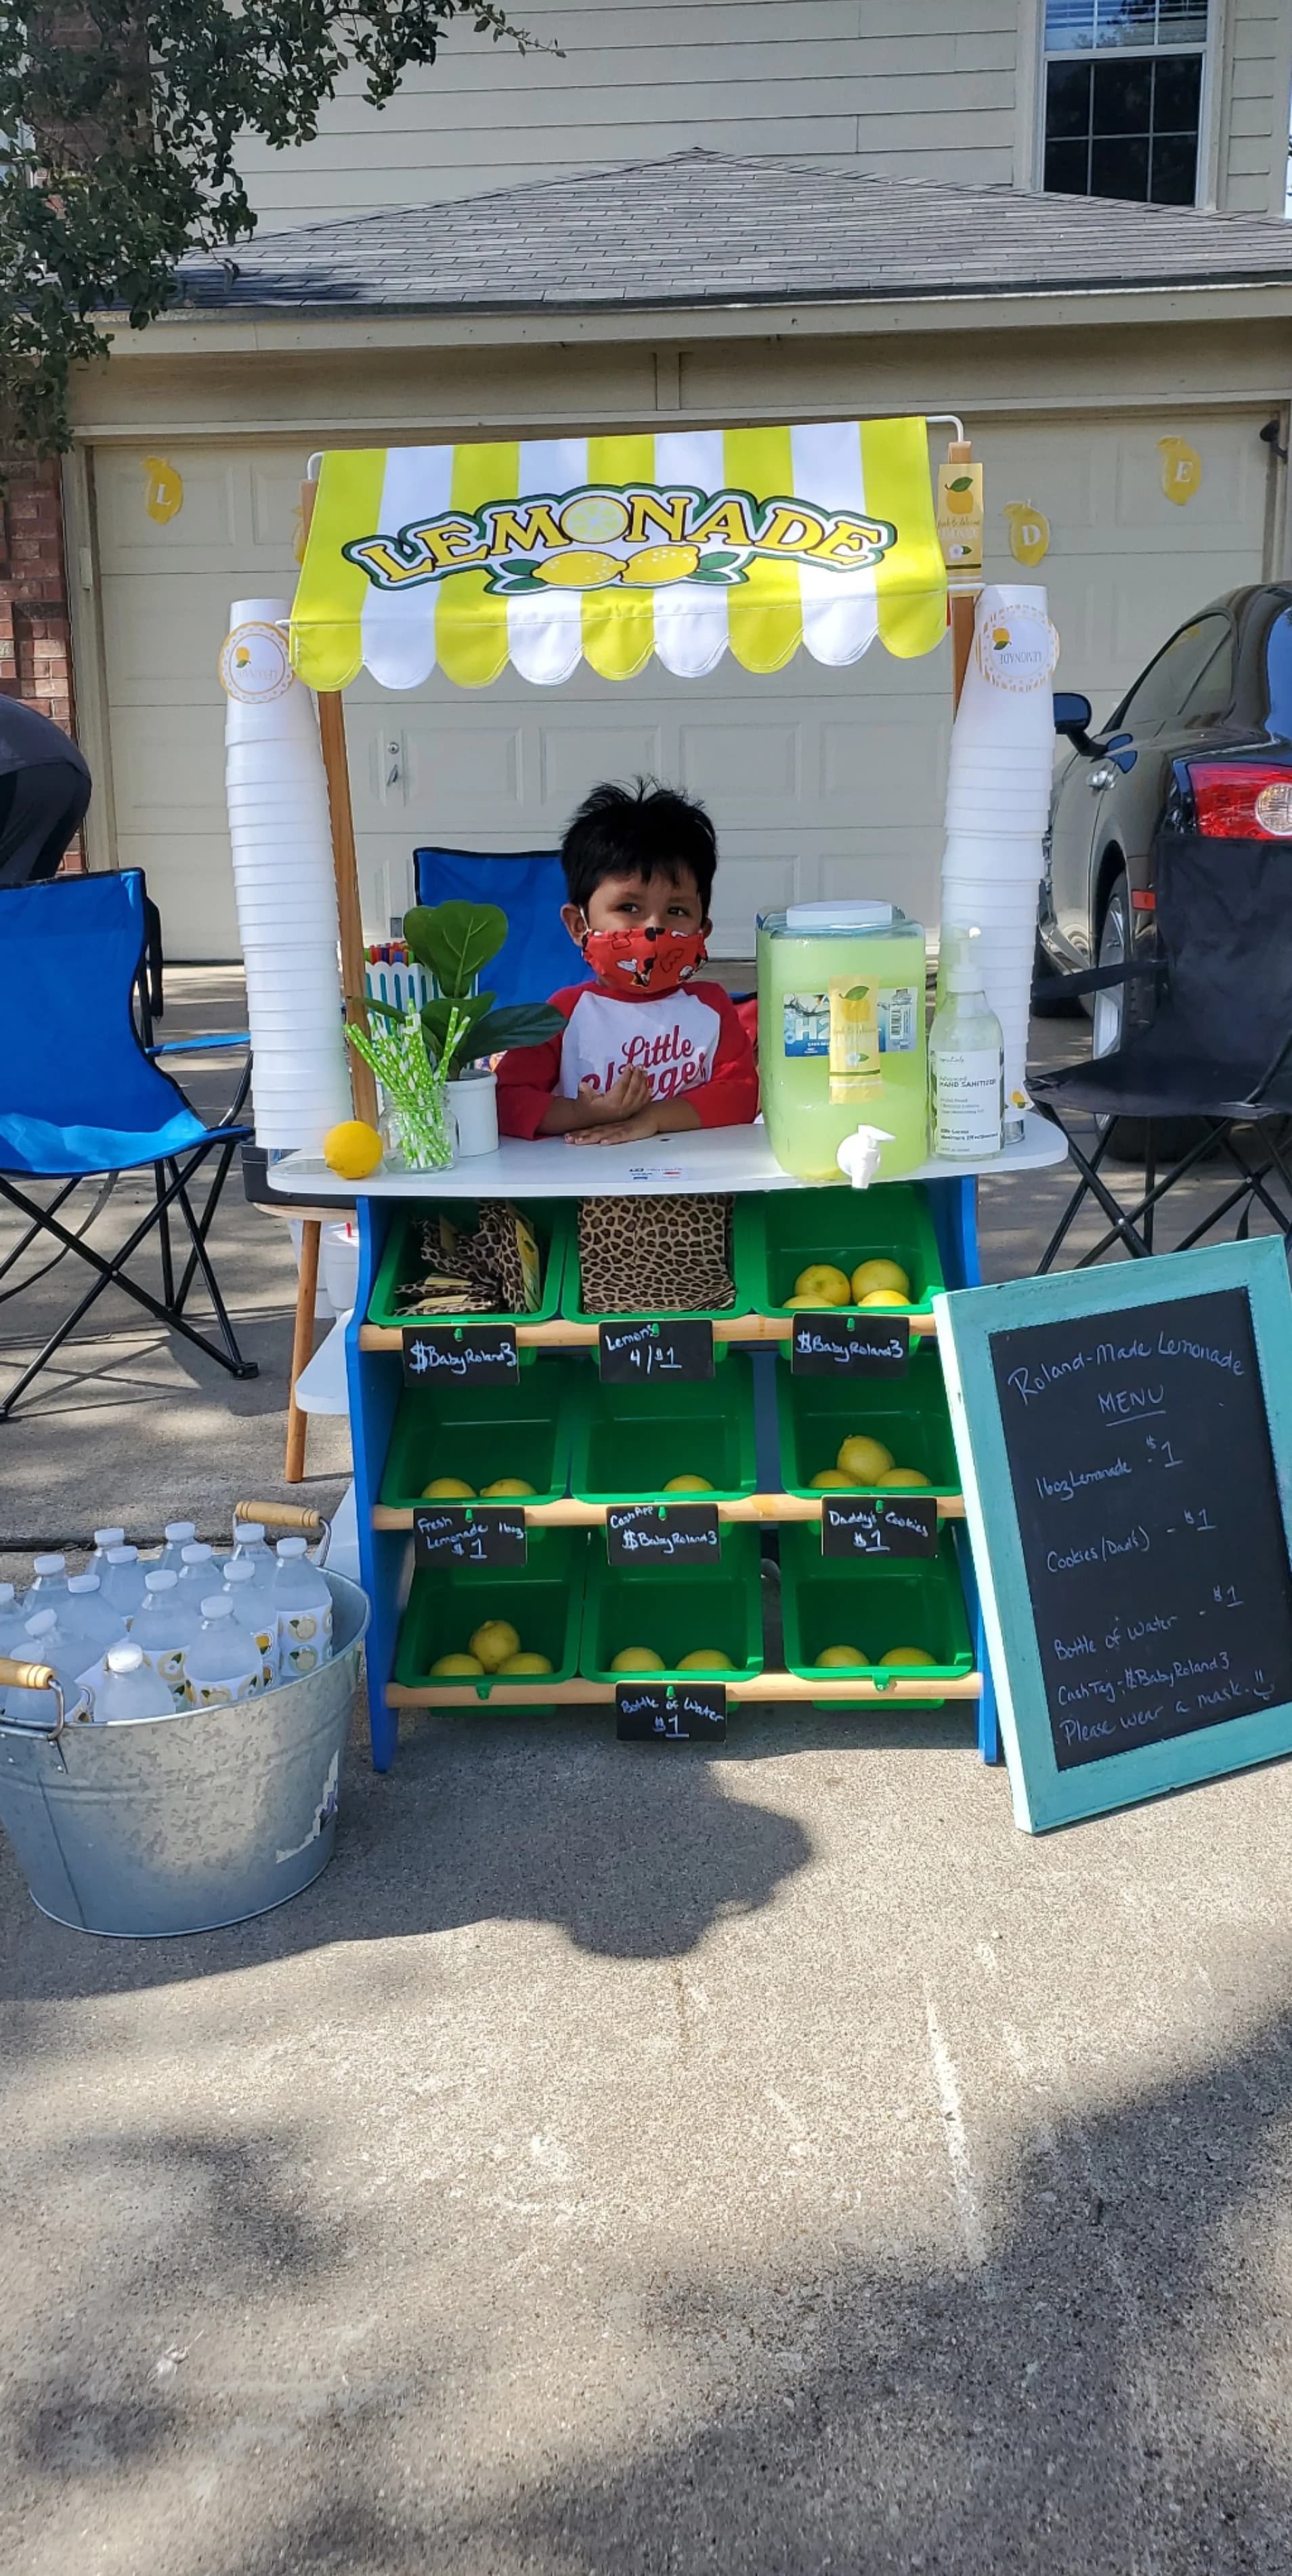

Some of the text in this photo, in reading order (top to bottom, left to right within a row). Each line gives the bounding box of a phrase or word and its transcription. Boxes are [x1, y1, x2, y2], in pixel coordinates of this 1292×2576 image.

[156, 483, 172, 506] L
[357, 493, 883, 584] LEMONADE
[1021, 524, 1041, 546] D
[618, 1025, 695, 1073] Little
[1158, 1330, 1245, 1376] Lemonade
[1098, 1384, 1166, 1415] MENU
[417, 1516, 453, 1533] Fresh
[426, 1523, 489, 1550] Lemonade
[828, 1510, 929, 1537] Daddy's Cookies
[1047, 1547, 1099, 1572] Cookies
[1054, 1635, 1097, 1661] Bottle
[1104, 1628, 1121, 1649] of
[1127, 1613, 1178, 1640] Water
[620, 1695, 725, 1722] Bottle of Water
[1059, 1718, 1117, 1746] Please
[1120, 1705, 1164, 1727] wear
[1175, 1700, 1192, 1714] a
